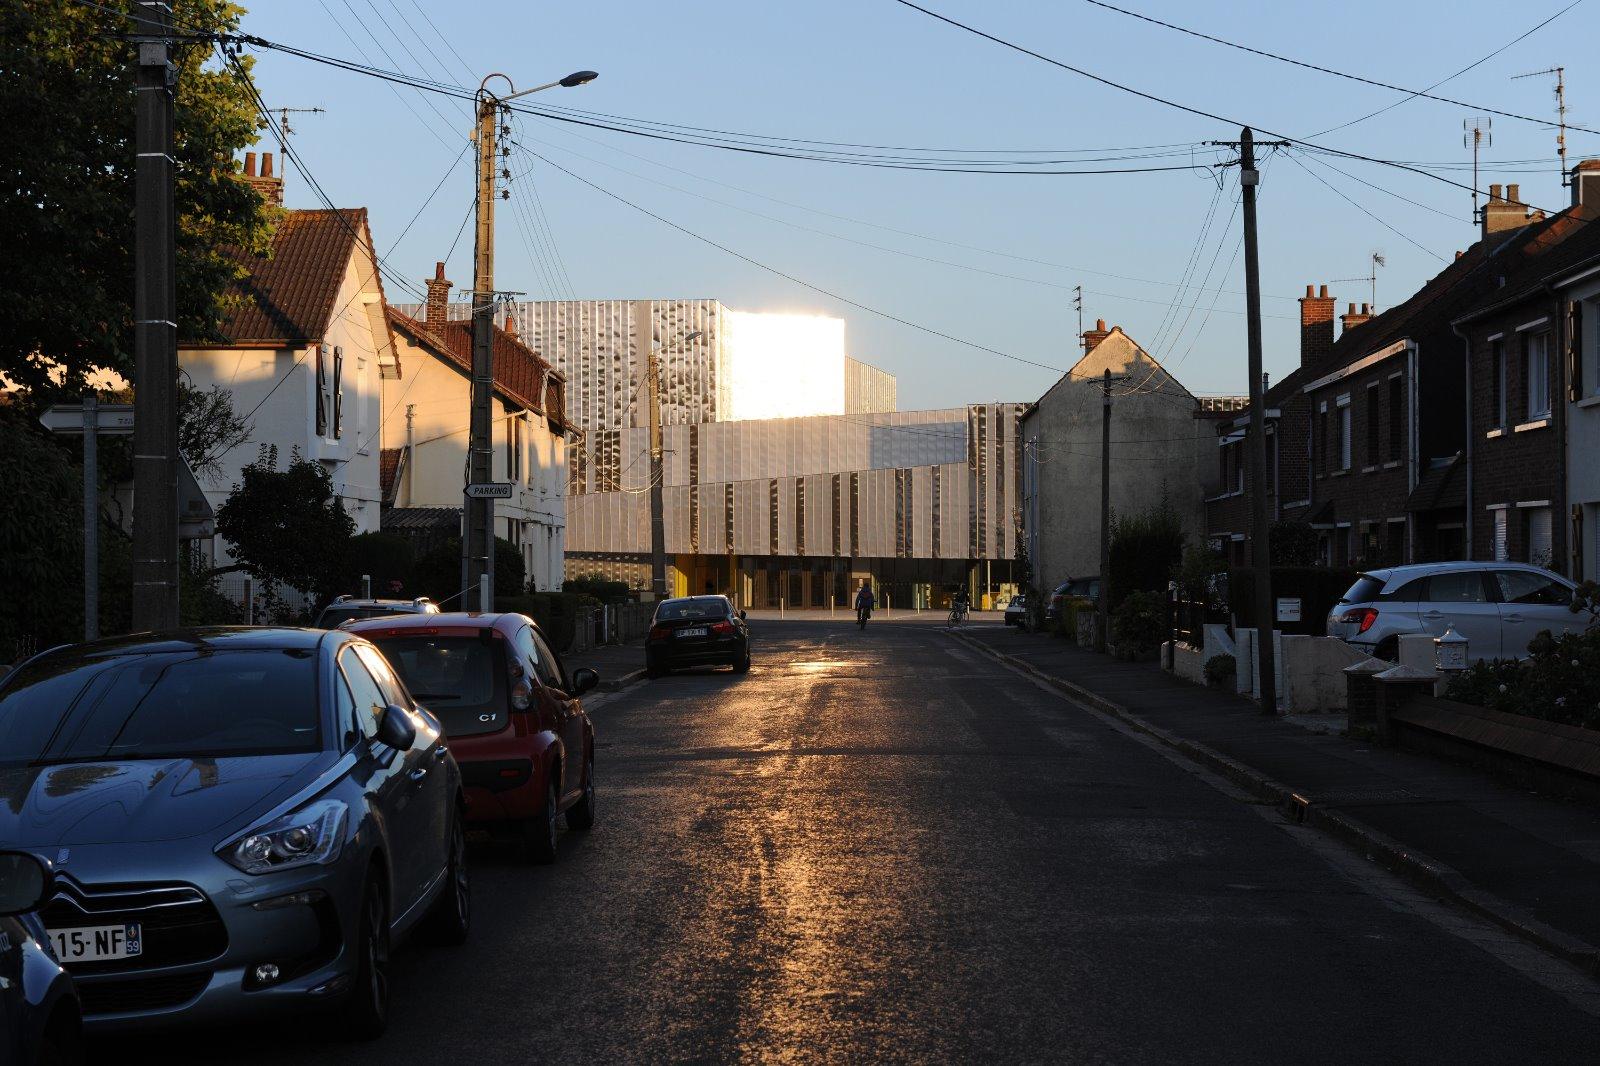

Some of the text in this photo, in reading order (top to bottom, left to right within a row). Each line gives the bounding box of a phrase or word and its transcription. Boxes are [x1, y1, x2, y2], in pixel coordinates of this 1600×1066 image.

[474, 486, 508, 495] PARKING
[479, 713, 497, 722] C1
[48, 929, 140, 957] 15-NF 59
